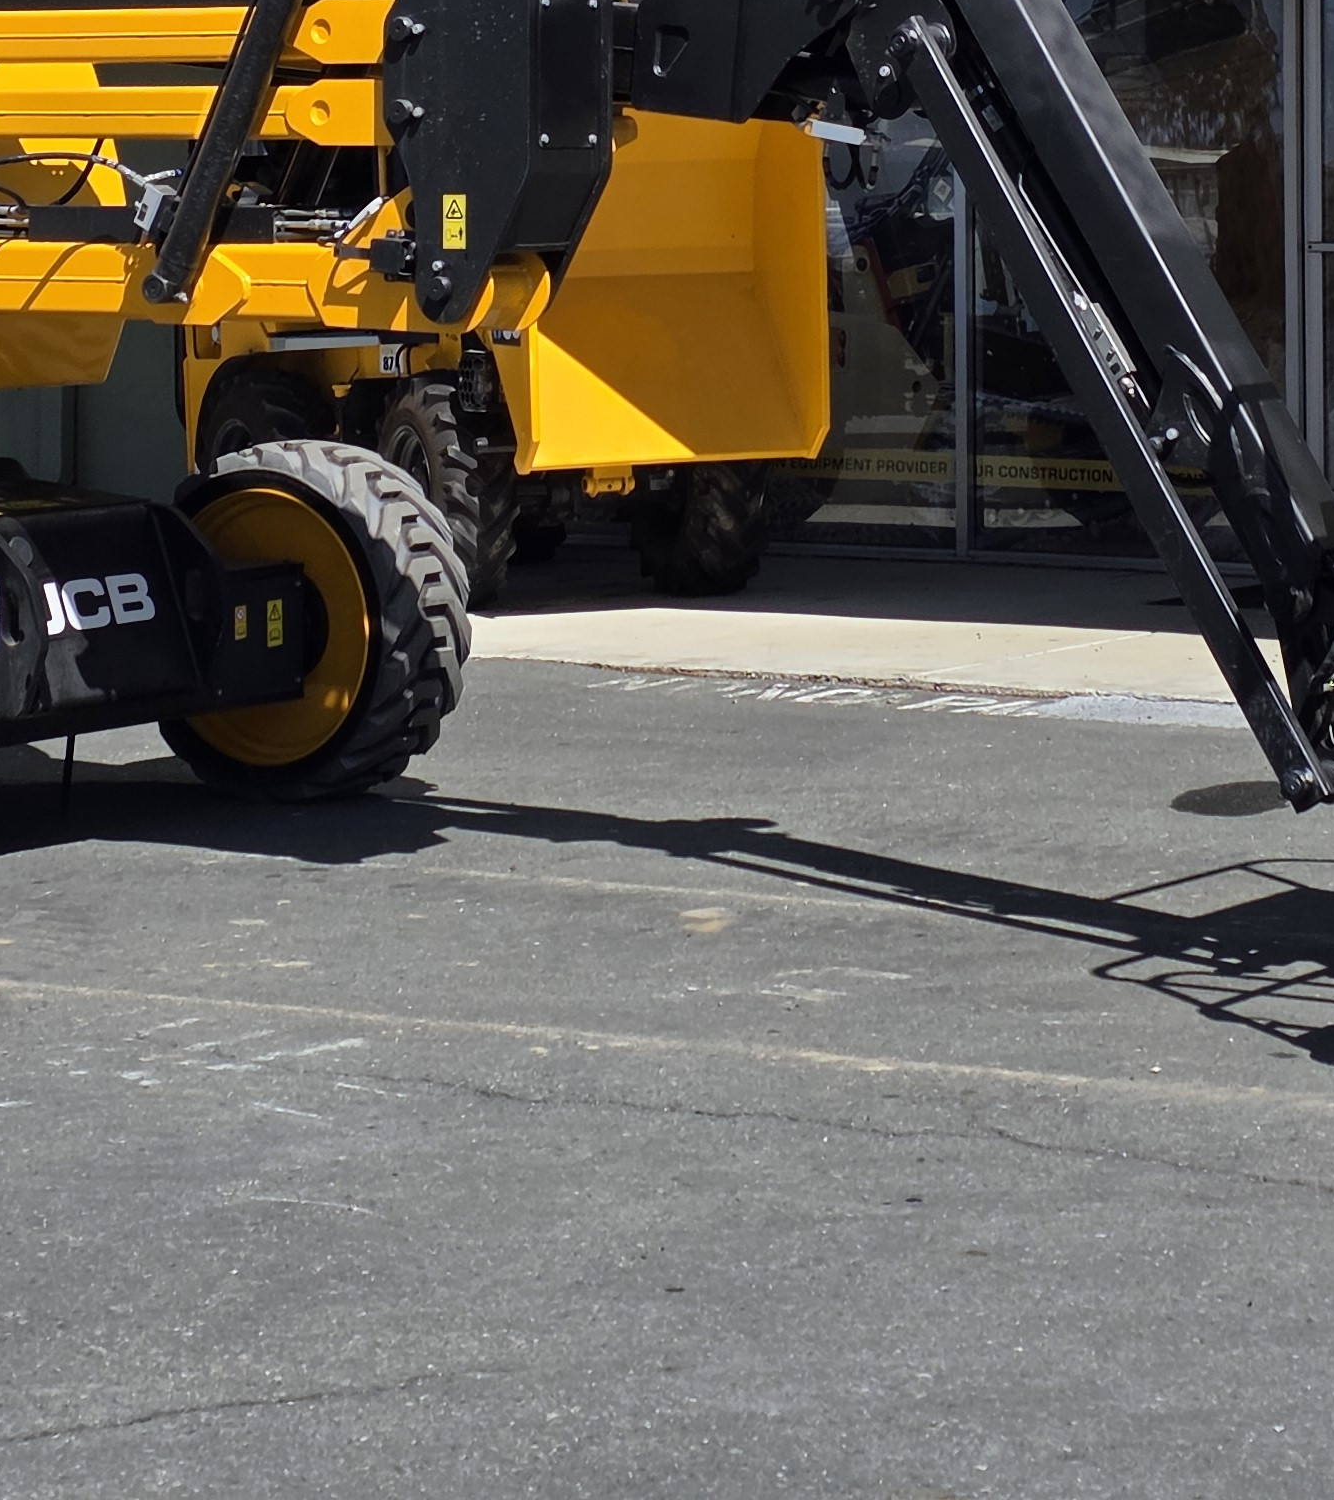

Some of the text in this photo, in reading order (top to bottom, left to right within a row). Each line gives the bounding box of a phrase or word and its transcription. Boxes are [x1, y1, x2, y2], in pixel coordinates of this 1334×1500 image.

[876, 459, 948, 474] PROVIDER
[998, 465, 1113, 483] CONSTRUCTION
[43, 573, 156, 636] JCB
